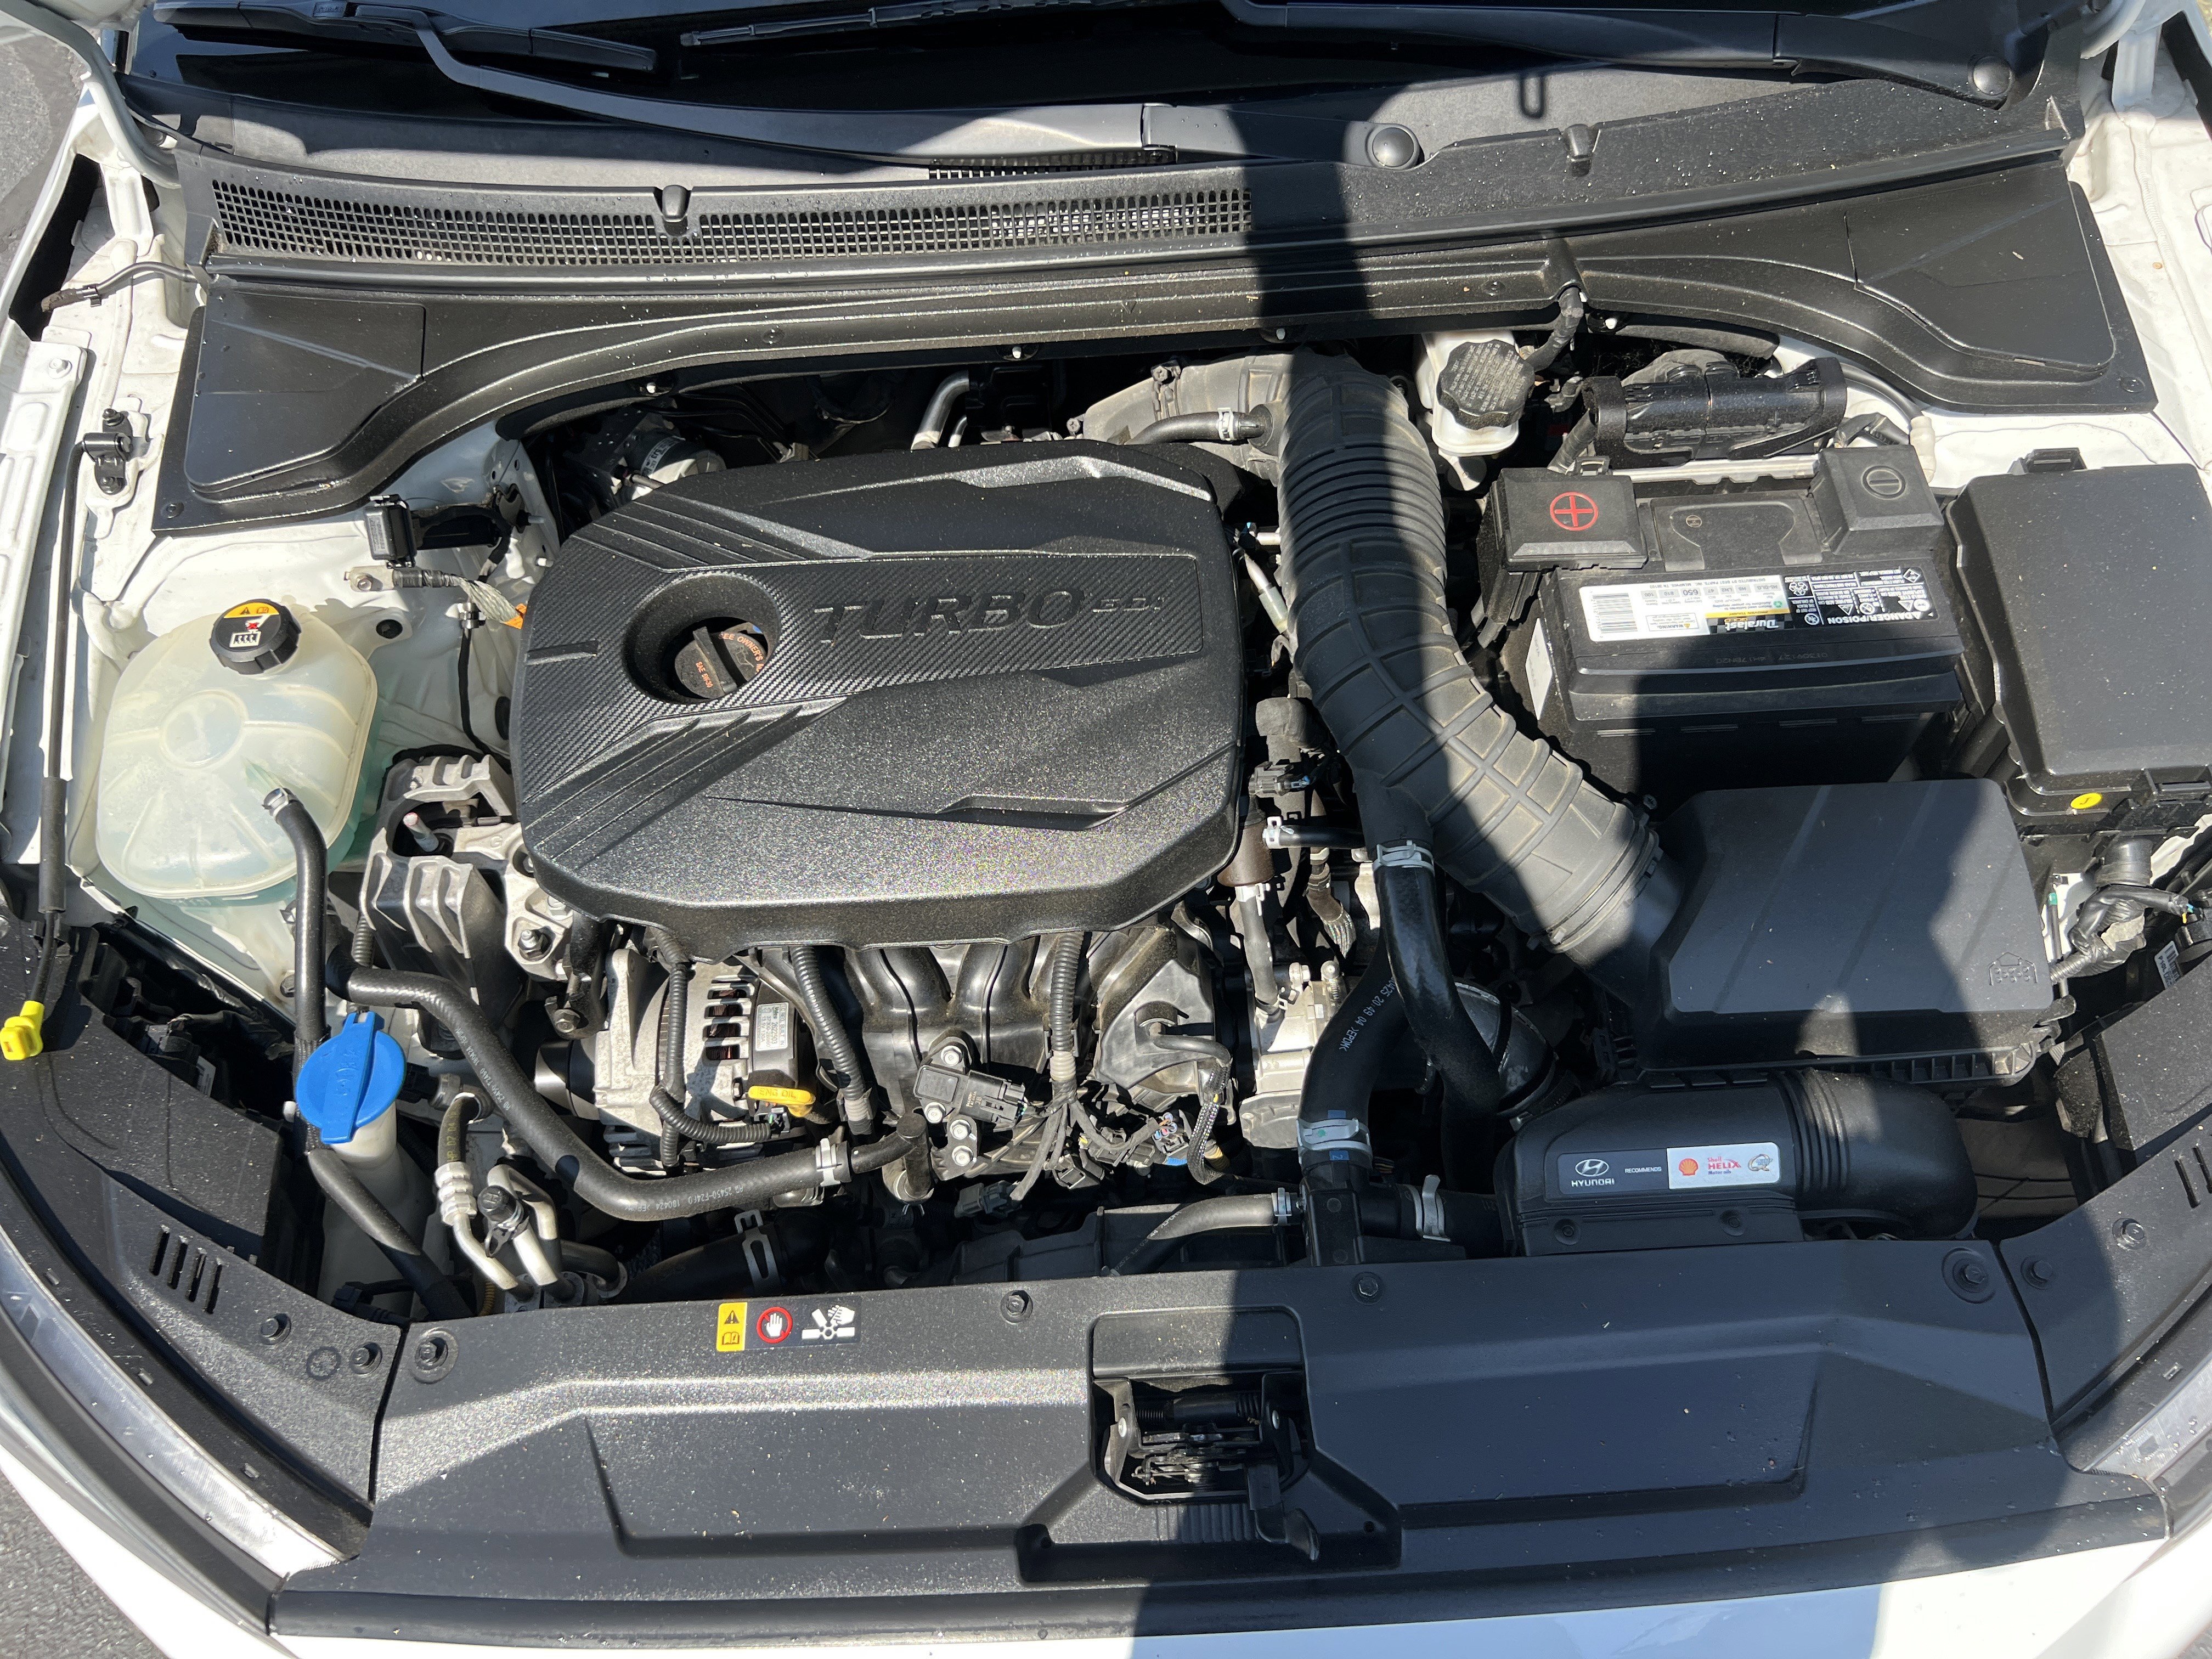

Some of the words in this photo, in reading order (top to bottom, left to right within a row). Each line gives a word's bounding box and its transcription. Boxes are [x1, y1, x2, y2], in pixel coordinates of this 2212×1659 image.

[813, 588, 1086, 644] TURBO
[1725, 619, 1779, 630] Duralast
[1380, 977, 1396, 997] 0425
[759, 1088, 778, 1097] ENG
[782, 1090, 796, 1098] OIL
[1708, 1161, 1741, 1170] HELIX
[1571, 1178, 1615, 1188] HYUNDAI
